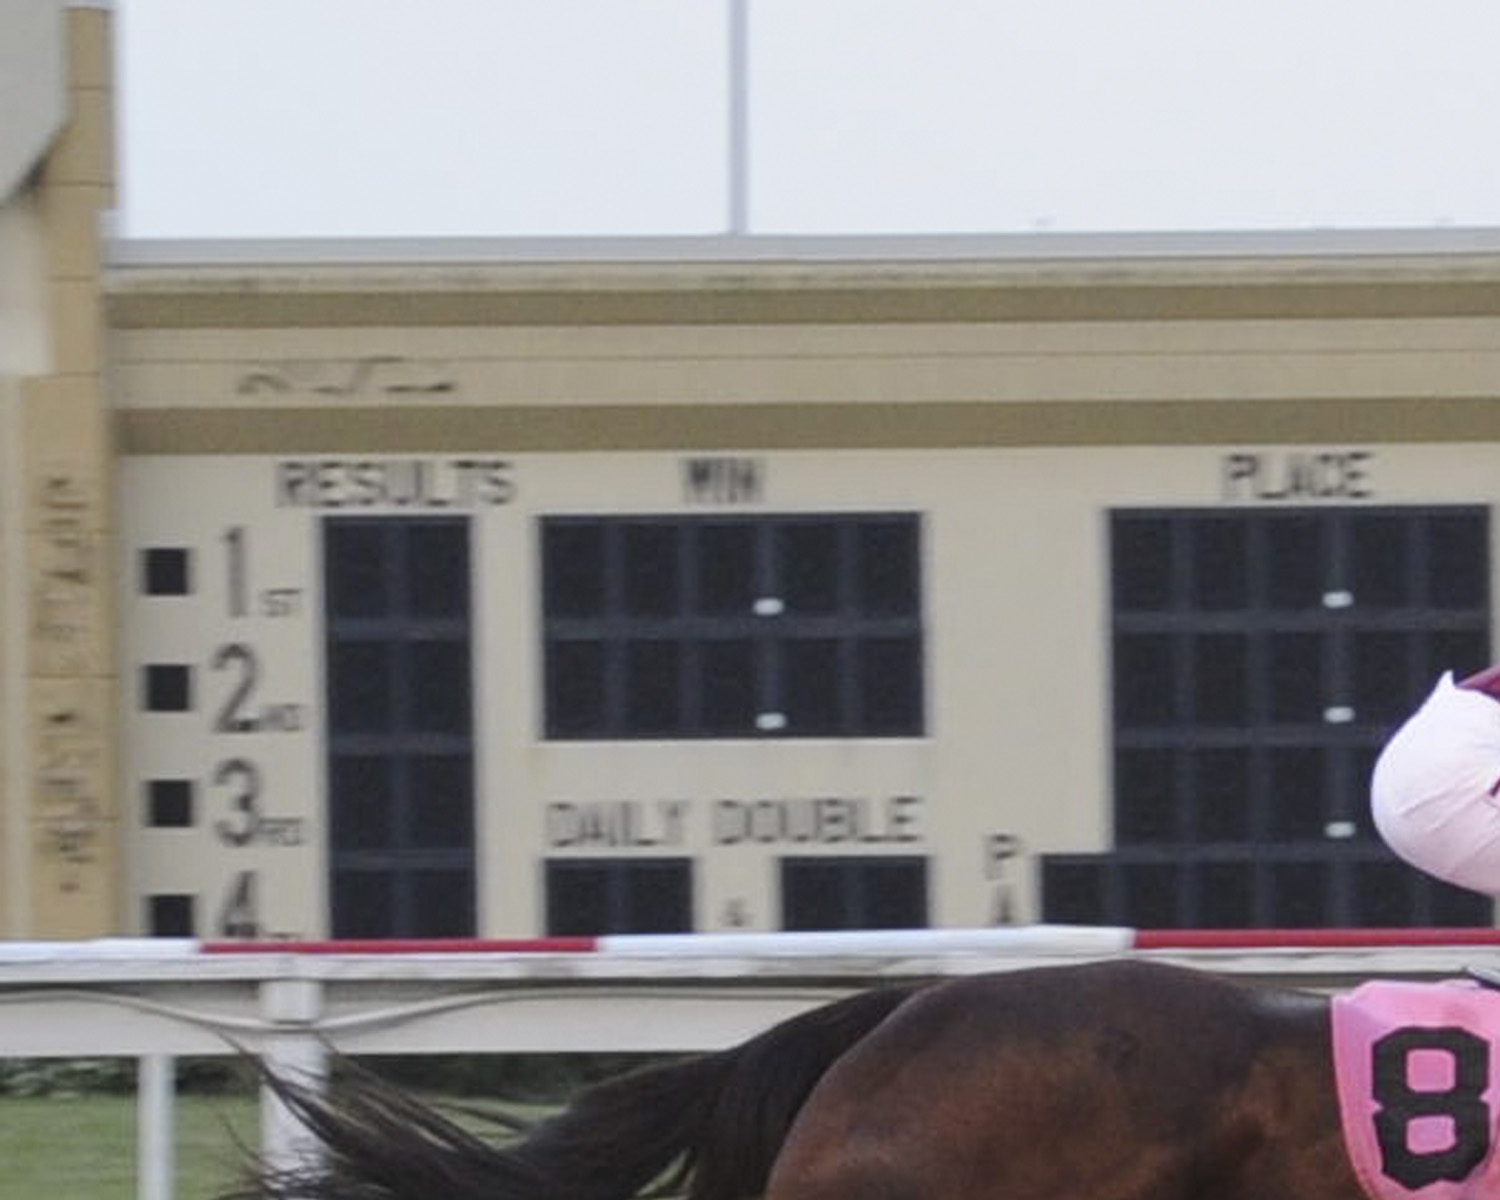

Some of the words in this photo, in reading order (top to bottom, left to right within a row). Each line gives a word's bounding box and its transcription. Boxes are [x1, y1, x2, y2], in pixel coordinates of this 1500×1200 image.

[278, 459, 517, 507] RESULTS
[1221, 452, 1373, 500] PLACE
[549, 801, 686, 847] DAILY
[712, 797, 924, 845] DOUBLE
[1371, 1025, 1491, 1190] 8
